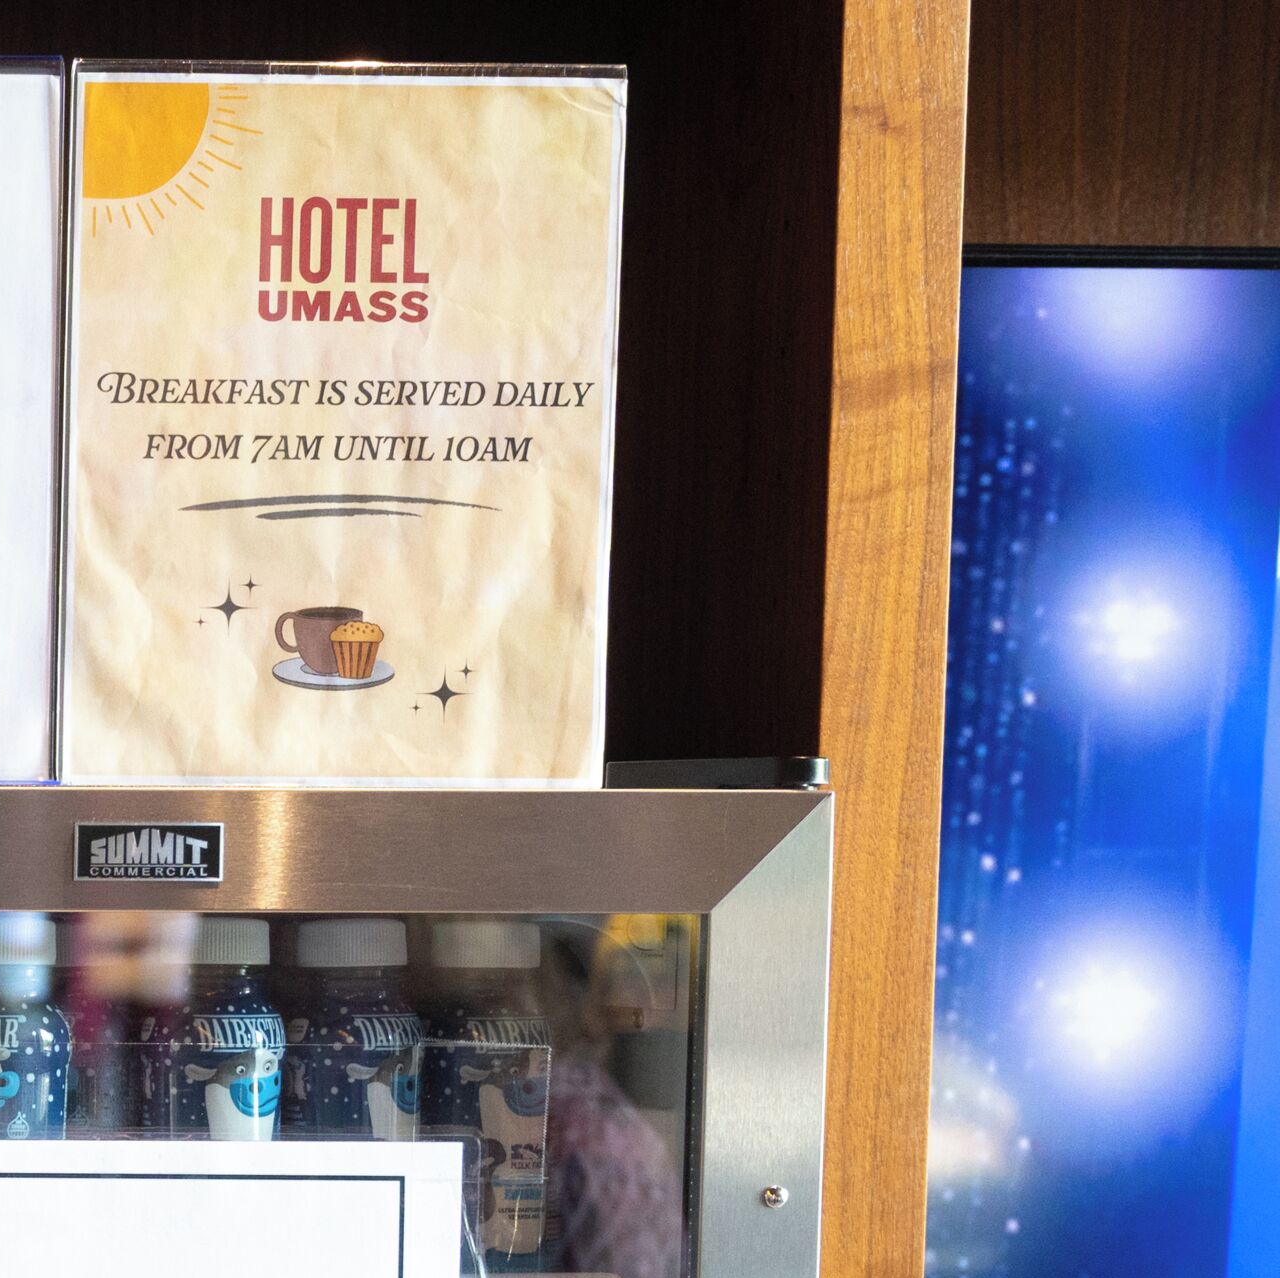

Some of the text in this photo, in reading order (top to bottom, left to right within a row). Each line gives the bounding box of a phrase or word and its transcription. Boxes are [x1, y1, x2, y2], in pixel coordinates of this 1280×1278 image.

[259, 196, 429, 285] HOTEL
[257, 290, 429, 323] UMASS
[96, 371, 594, 408] BREAKFAST IS SERVED DAILY
[143, 433, 532, 464] FROM 7AM UNTIL 10AM
[90, 828, 208, 864] SUMMIT
[90, 867, 208, 877] COMMERCIAL
